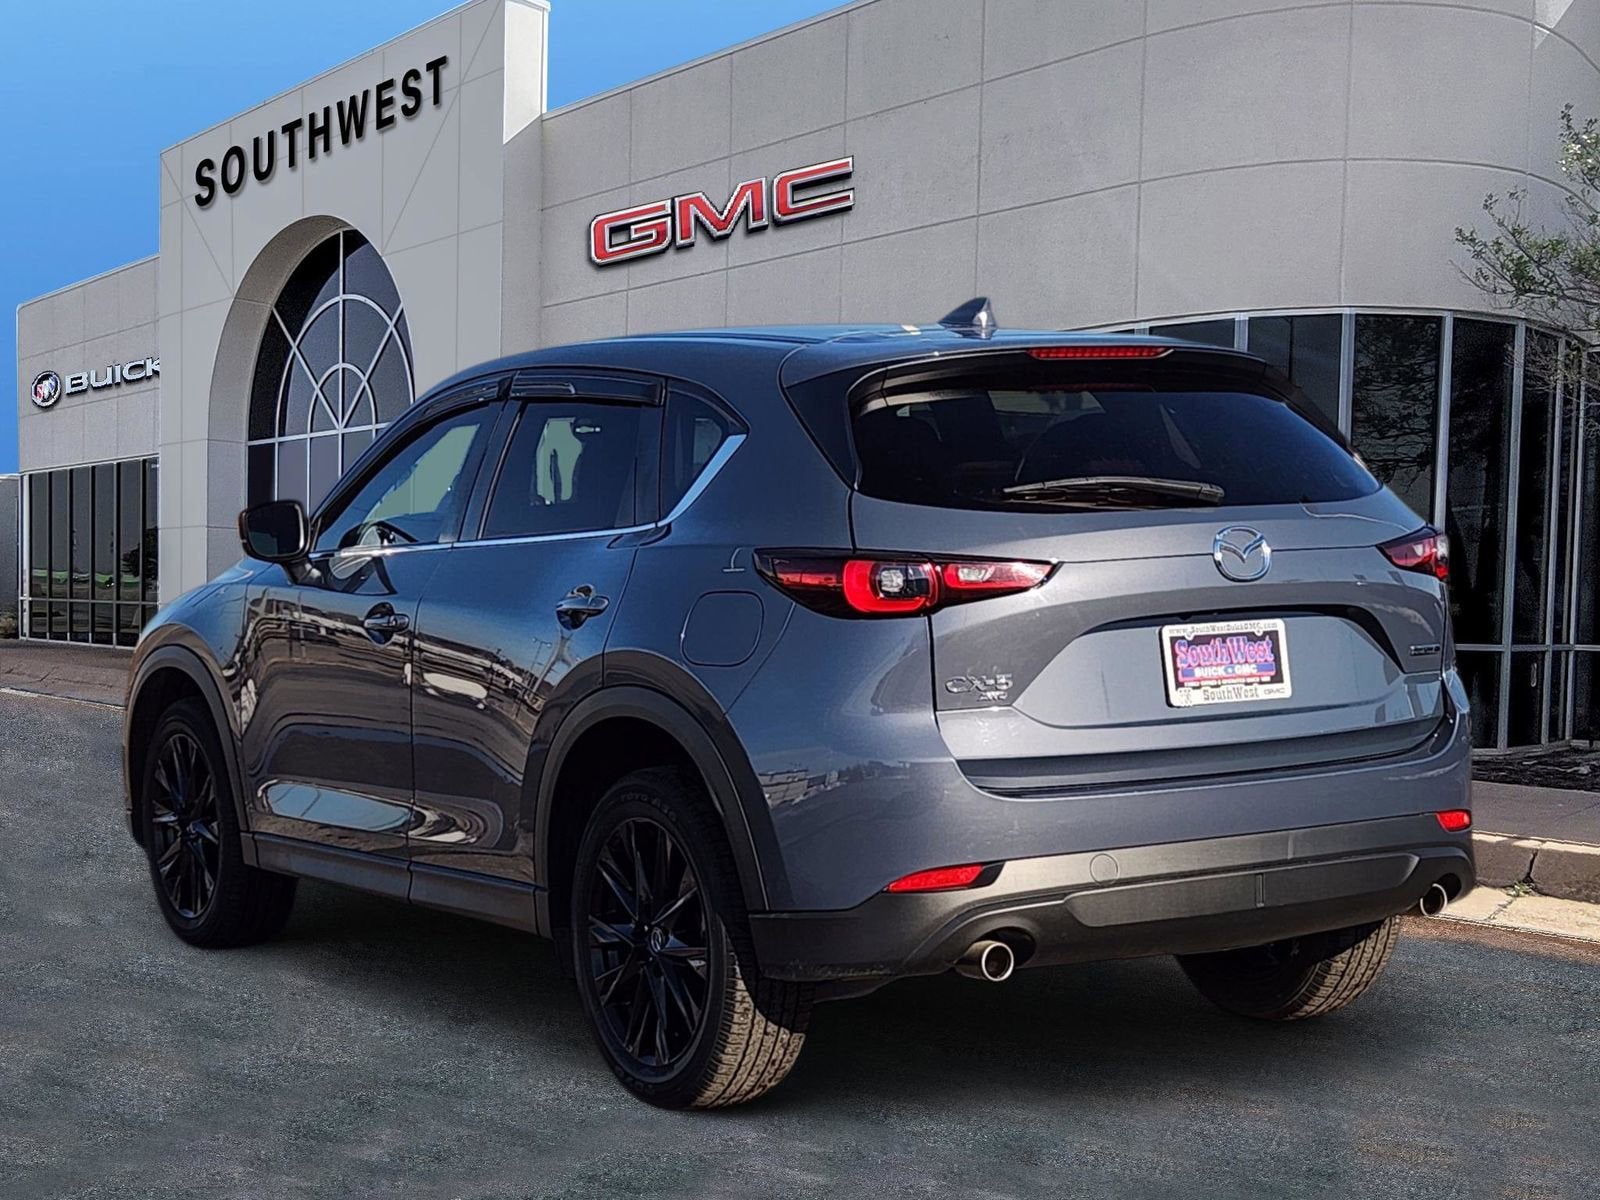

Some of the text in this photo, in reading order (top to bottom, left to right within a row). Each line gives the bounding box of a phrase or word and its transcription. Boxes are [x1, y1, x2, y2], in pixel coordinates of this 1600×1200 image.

[194, 55, 449, 207] SOUTHWEST
[588, 155, 855, 266] GMC
[1174, 635, 1275, 669] SouthWest
[944, 673, 1013, 694] CX-5
[1194, 664, 1258, 678] BUICK GMC
[1202, 685, 1286, 701] SouthWest GMC
